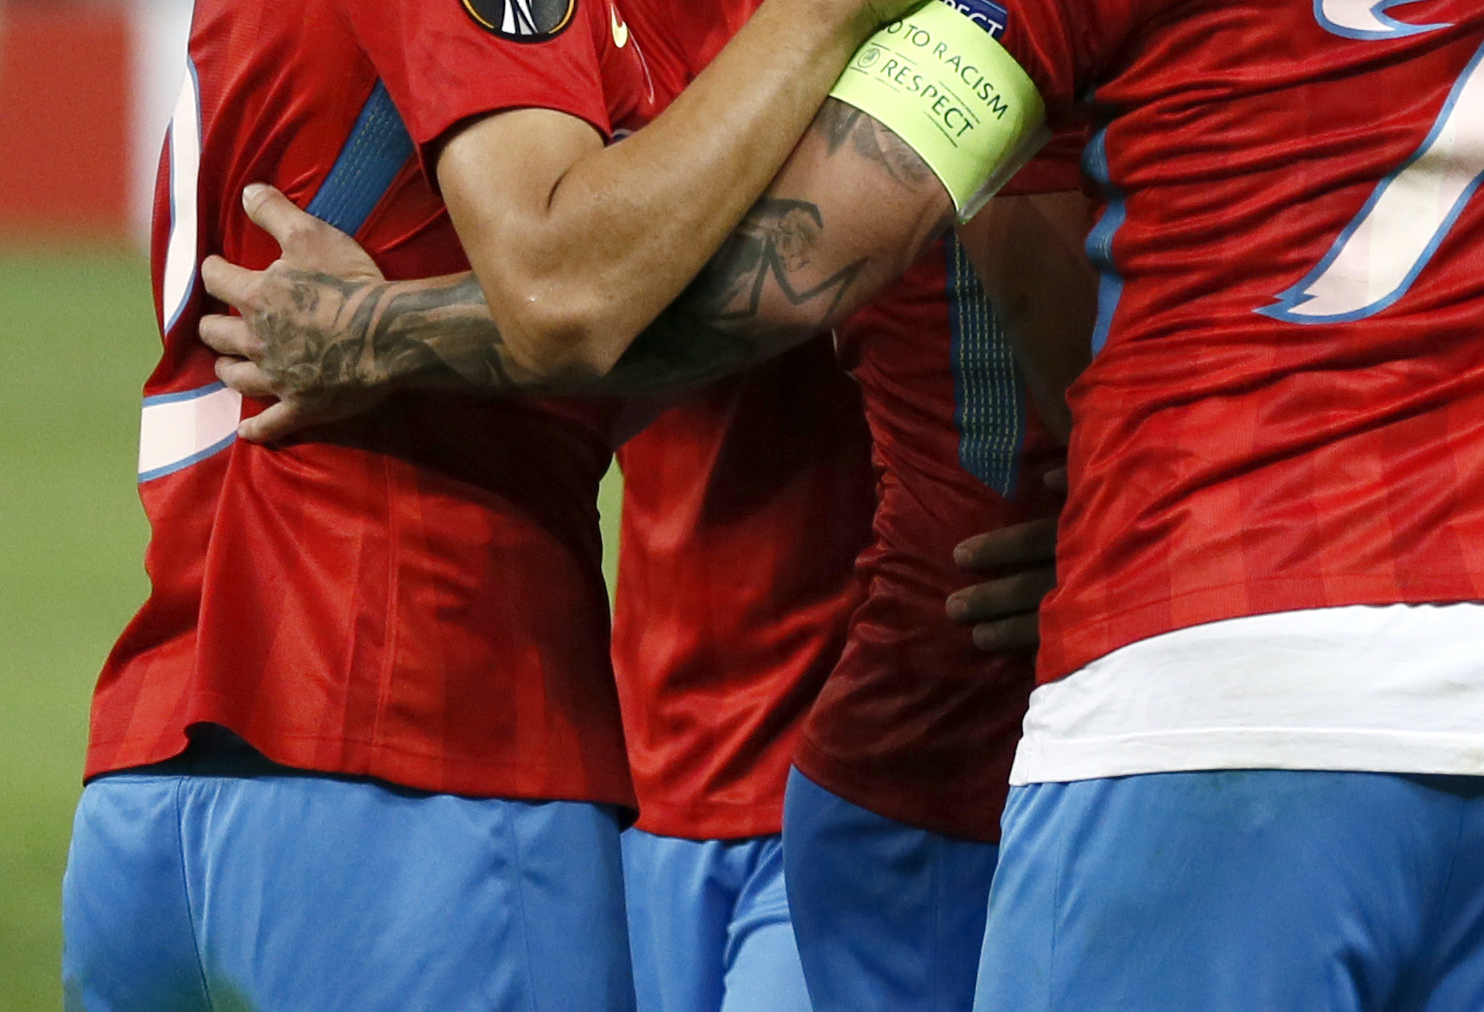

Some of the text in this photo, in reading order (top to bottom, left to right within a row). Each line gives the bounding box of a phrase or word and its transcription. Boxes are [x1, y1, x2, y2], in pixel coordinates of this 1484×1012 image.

[880, 58, 974, 138] RESPECT
[903, 24, 930, 47] TO
[932, 41, 1009, 121] RACISM
